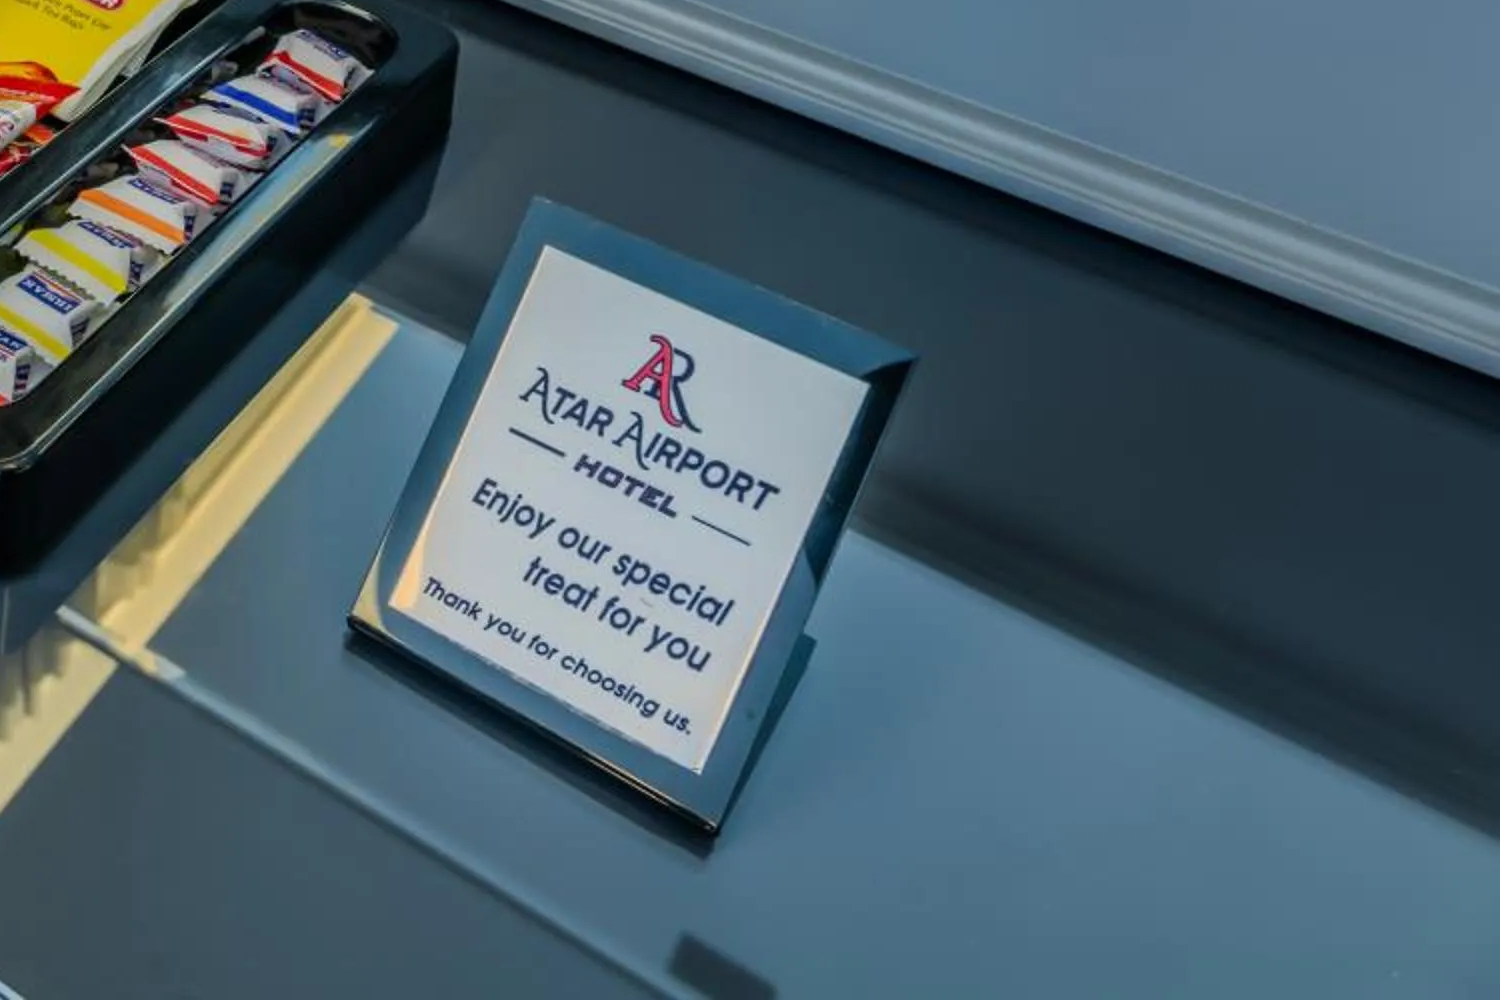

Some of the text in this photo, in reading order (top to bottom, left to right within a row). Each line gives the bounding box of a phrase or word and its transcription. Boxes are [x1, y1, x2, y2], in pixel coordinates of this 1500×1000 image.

[518, 366, 781, 511] ATAR AIRPORT
[573, 453, 677, 519] HOTEL
[471, 477, 735, 627] Enjoy our special
[523, 556, 712, 673] treat for you
[422, 576, 693, 736] Thank you for choosing us.
